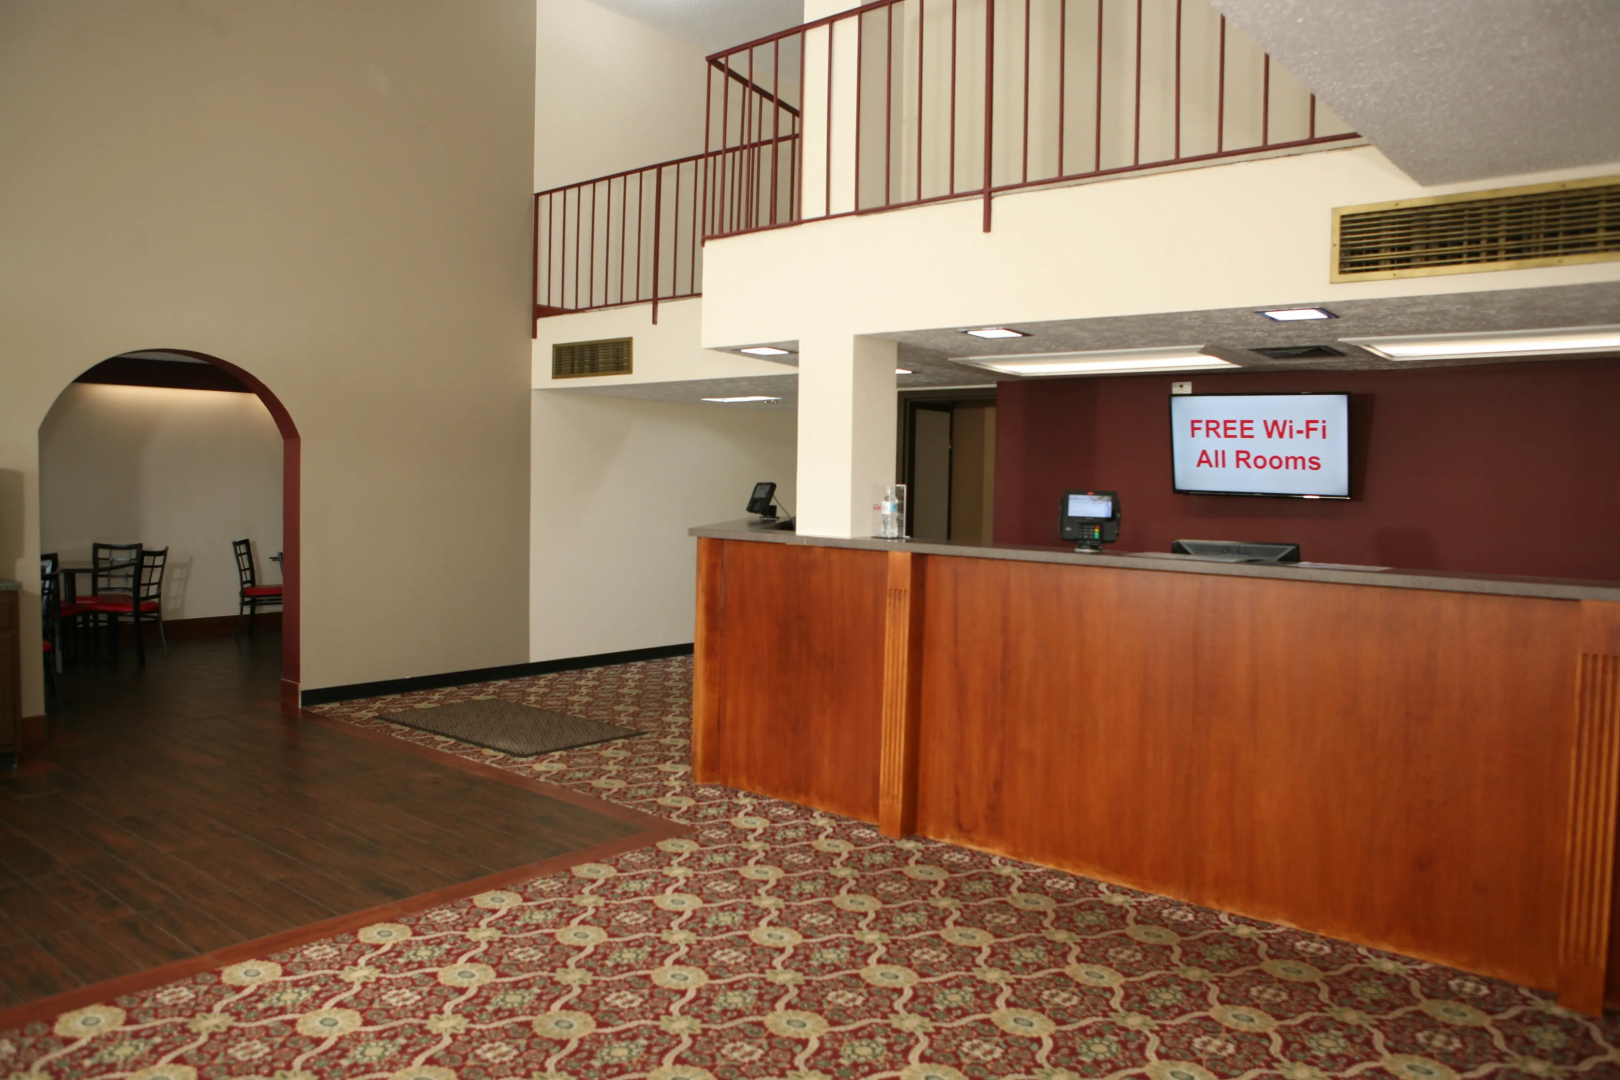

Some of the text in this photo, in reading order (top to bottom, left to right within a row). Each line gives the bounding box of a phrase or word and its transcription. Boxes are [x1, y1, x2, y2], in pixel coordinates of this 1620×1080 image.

[1190, 419, 1327, 440] FREE Wi-Fi
[1196, 449, 1322, 471] All Rooms
